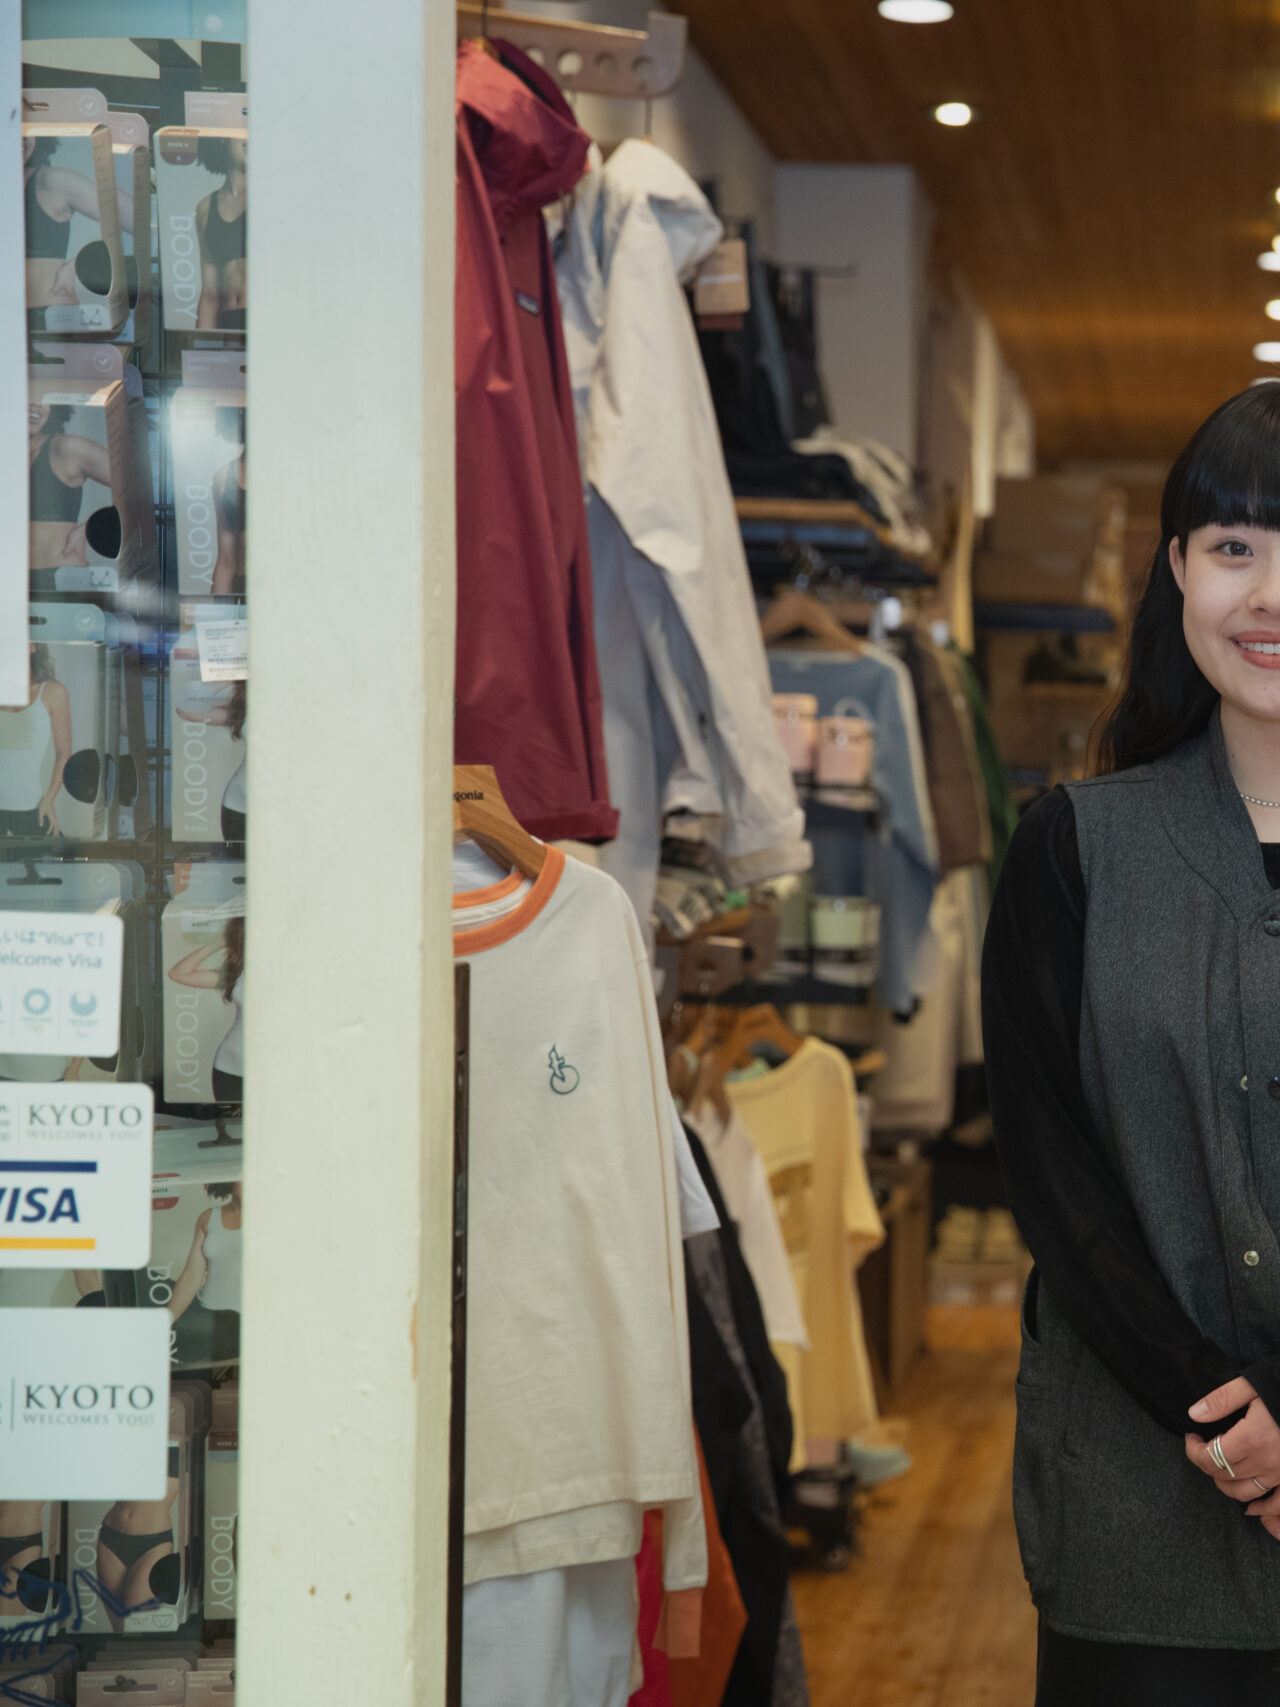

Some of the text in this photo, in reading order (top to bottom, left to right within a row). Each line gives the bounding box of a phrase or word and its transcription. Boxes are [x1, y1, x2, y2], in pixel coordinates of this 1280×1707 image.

[170, 215, 198, 319] BOODY
[186, 486, 213, 584] BOODY
[183, 721, 208, 822] BOODY
[453, 789, 484, 803] gonia
[0, 951, 103, 968] elcome Visa
[175, 994, 200, 1093] BOODY
[28, 1104, 142, 1127] KYOTO
[23, 1413, 109, 1425] WELCOMES
[25, 1384, 154, 1410] KYOTO
[211, 1516, 234, 1610] BOODY
